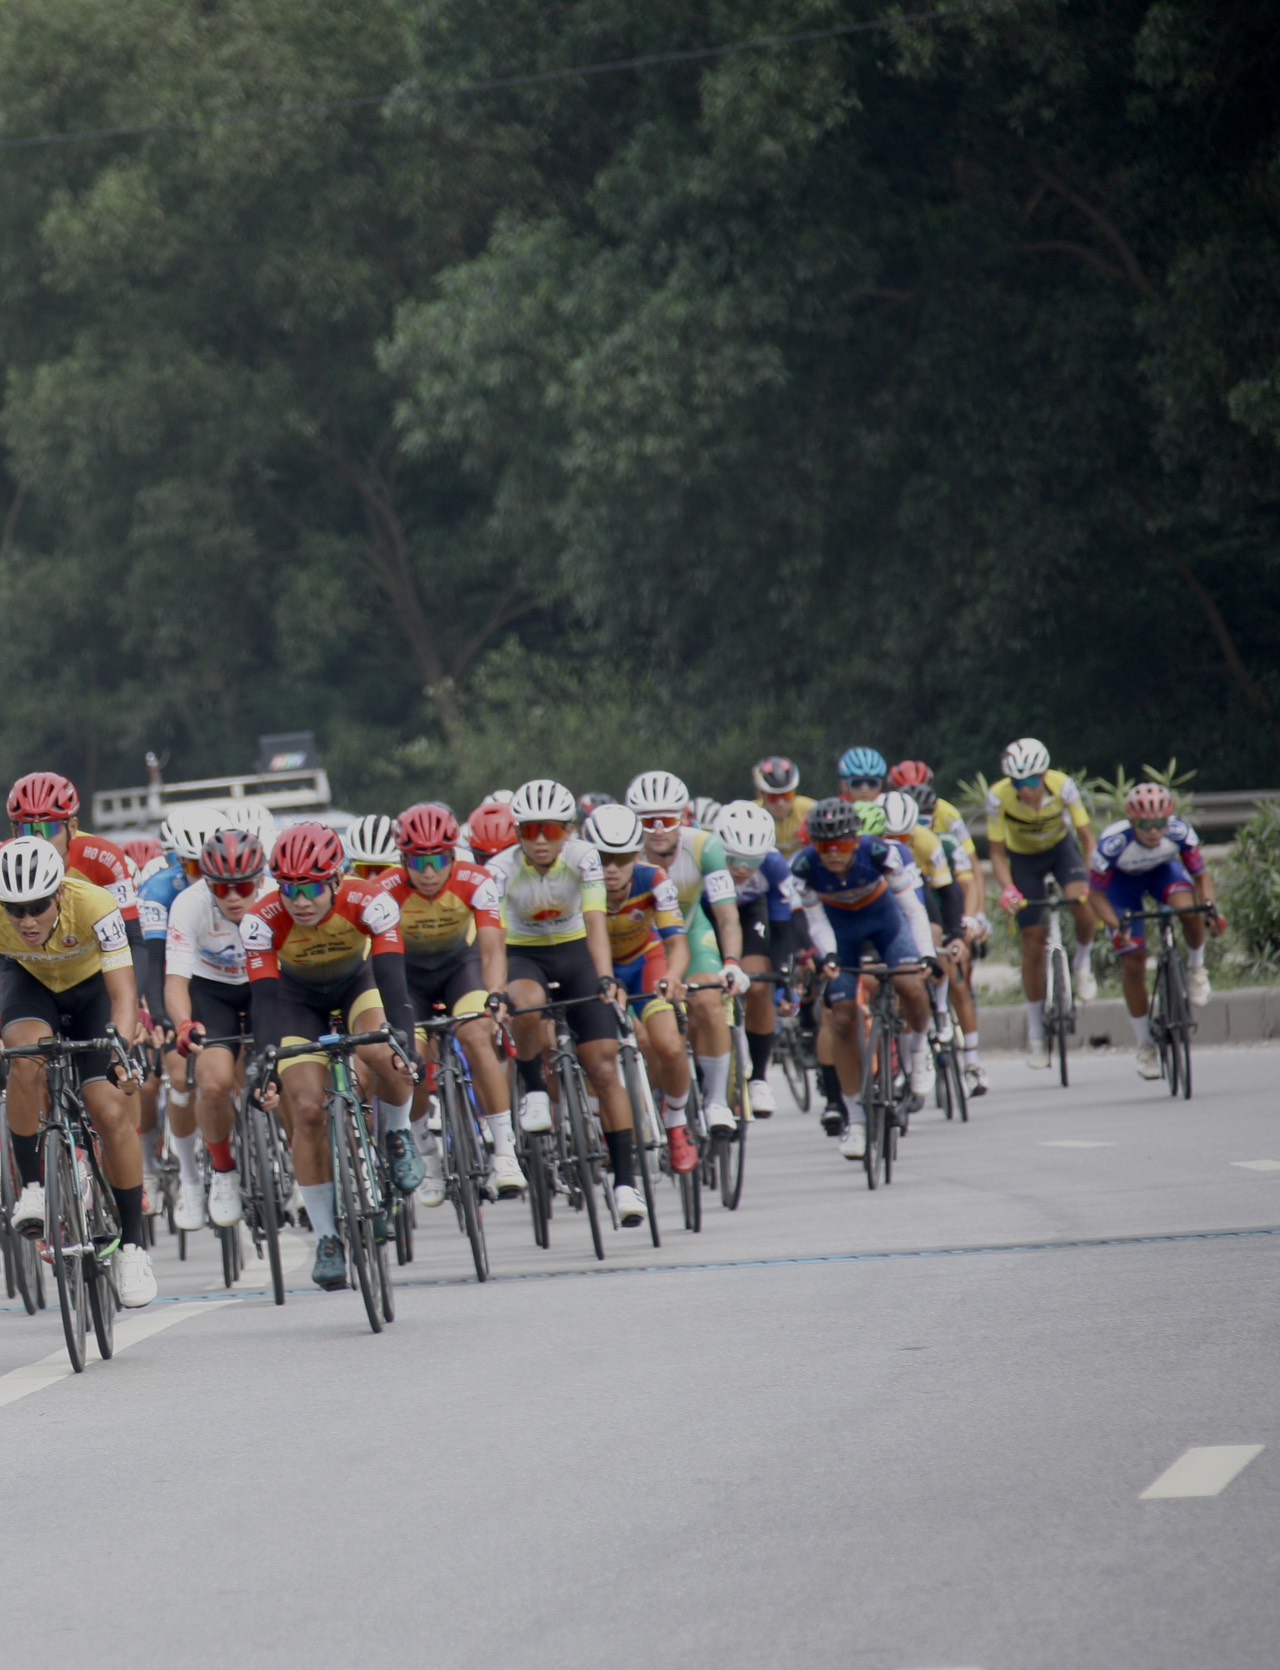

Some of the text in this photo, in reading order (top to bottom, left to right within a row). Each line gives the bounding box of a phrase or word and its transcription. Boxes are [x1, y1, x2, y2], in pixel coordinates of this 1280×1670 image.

[83, 845, 99, 860] HO
[98, 850, 117, 868] CHI
[381, 874, 402, 890] CITY
[346, 891, 361, 903] HO
[261, 901, 283, 919] CITY
[375, 903, 390, 919] 2
[248, 921, 260, 940] 2
